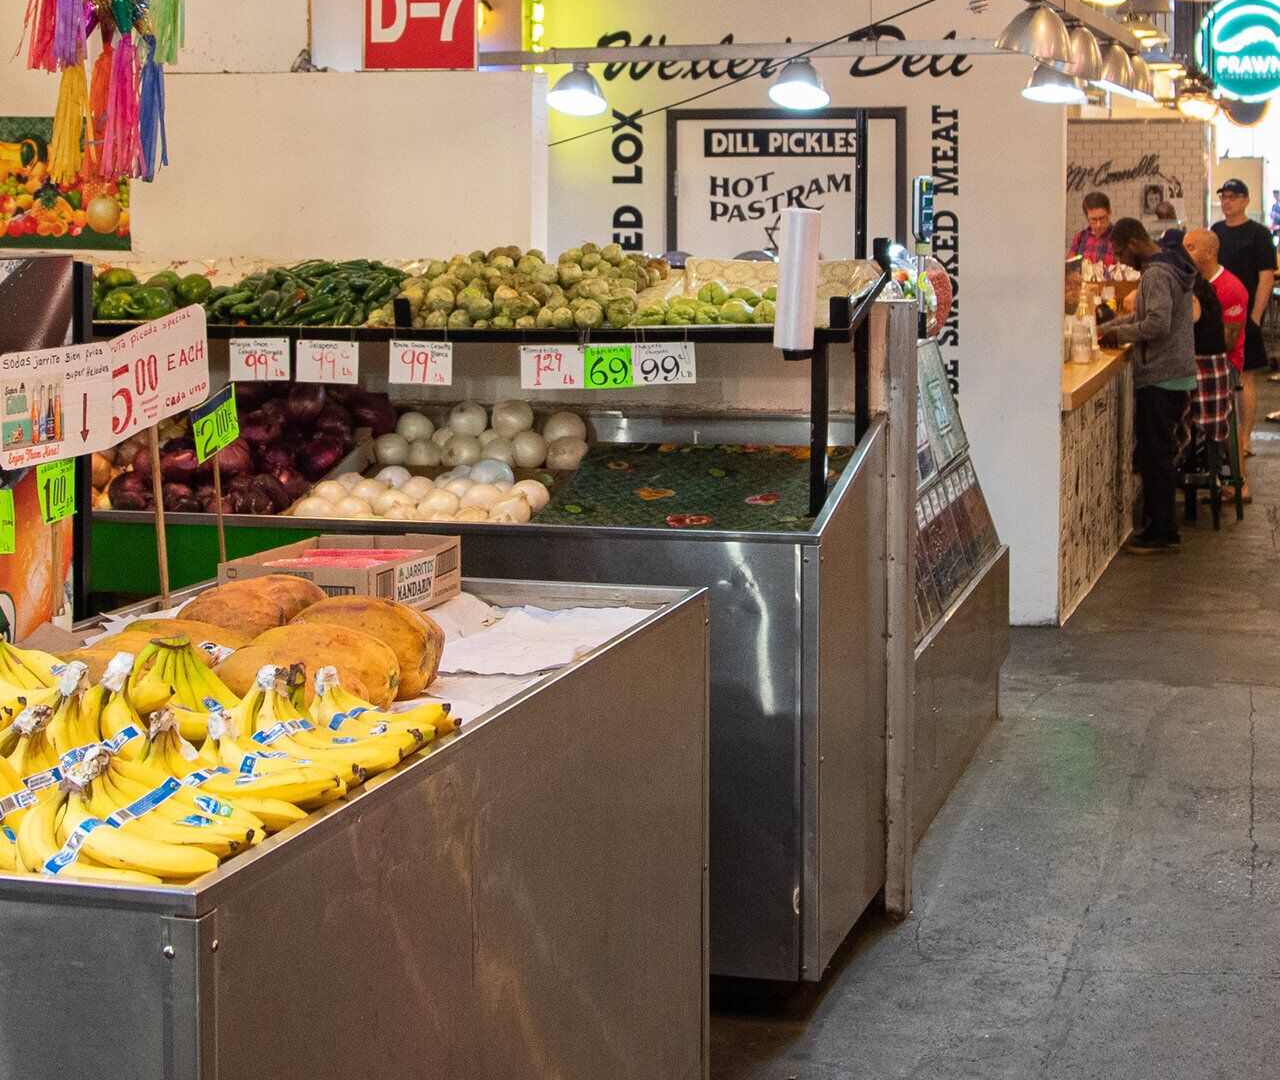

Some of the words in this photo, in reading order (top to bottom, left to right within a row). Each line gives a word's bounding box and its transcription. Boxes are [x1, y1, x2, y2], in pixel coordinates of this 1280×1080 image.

[847, 24, 975, 78] Deli
[611, 108, 644, 184] LOX
[711, 132, 760, 154] DILL
[768, 132, 856, 154] PICKLES
[931, 105, 960, 196] MEAT
[709, 172, 775, 199] HOT
[709, 173, 853, 223] PASTRAM
[130, 326, 158, 346] picada
[161, 310, 192, 330] special
[33, 354, 61, 371] jarrito
[65, 352, 81, 364] Bien
[166, 339, 204, 371] EACH
[590, 347, 625, 356] banana
[165, 391, 186, 408] cada
[188, 381, 207, 396] uno
